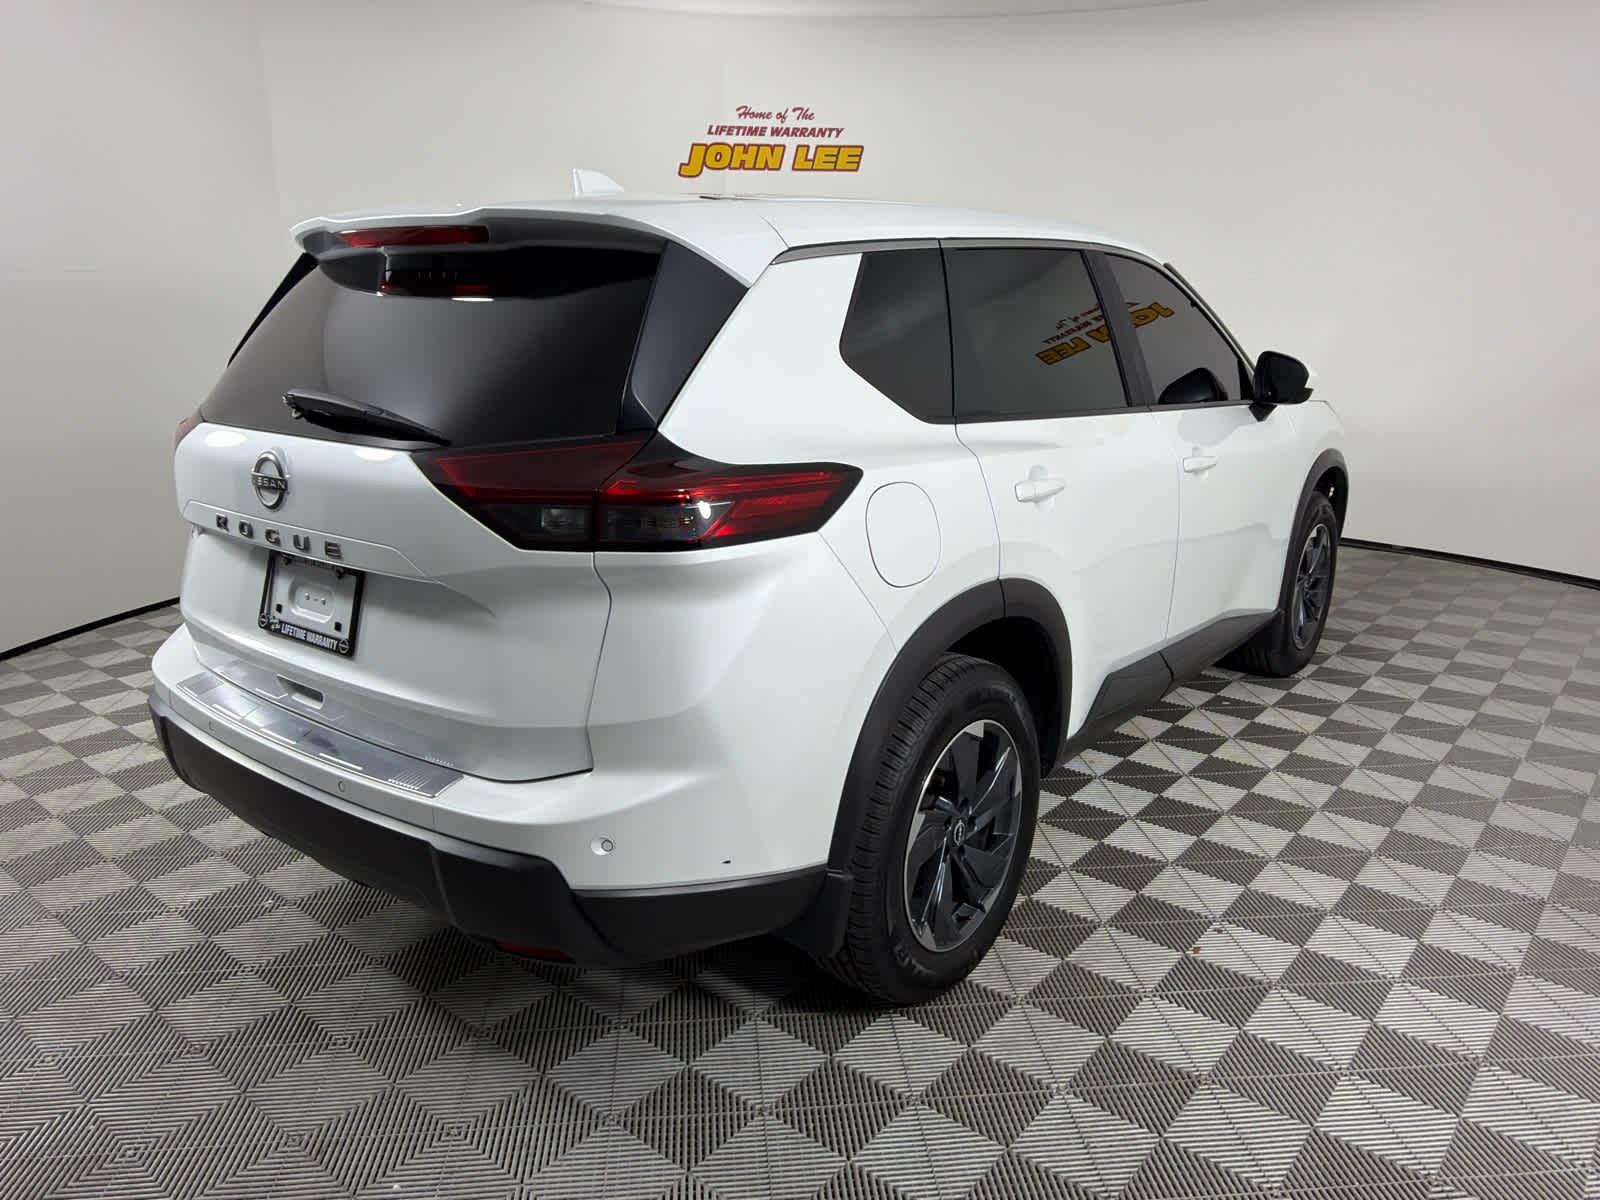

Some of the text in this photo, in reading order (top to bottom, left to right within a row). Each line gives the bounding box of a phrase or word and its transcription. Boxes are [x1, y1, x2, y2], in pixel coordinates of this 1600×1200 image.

[736, 105, 815, 124] Home of The
[707, 125, 844, 138] LIFETIME WARRANTY
[679, 143, 865, 178] JOHN LEE
[215, 513, 342, 559] ROGUE
